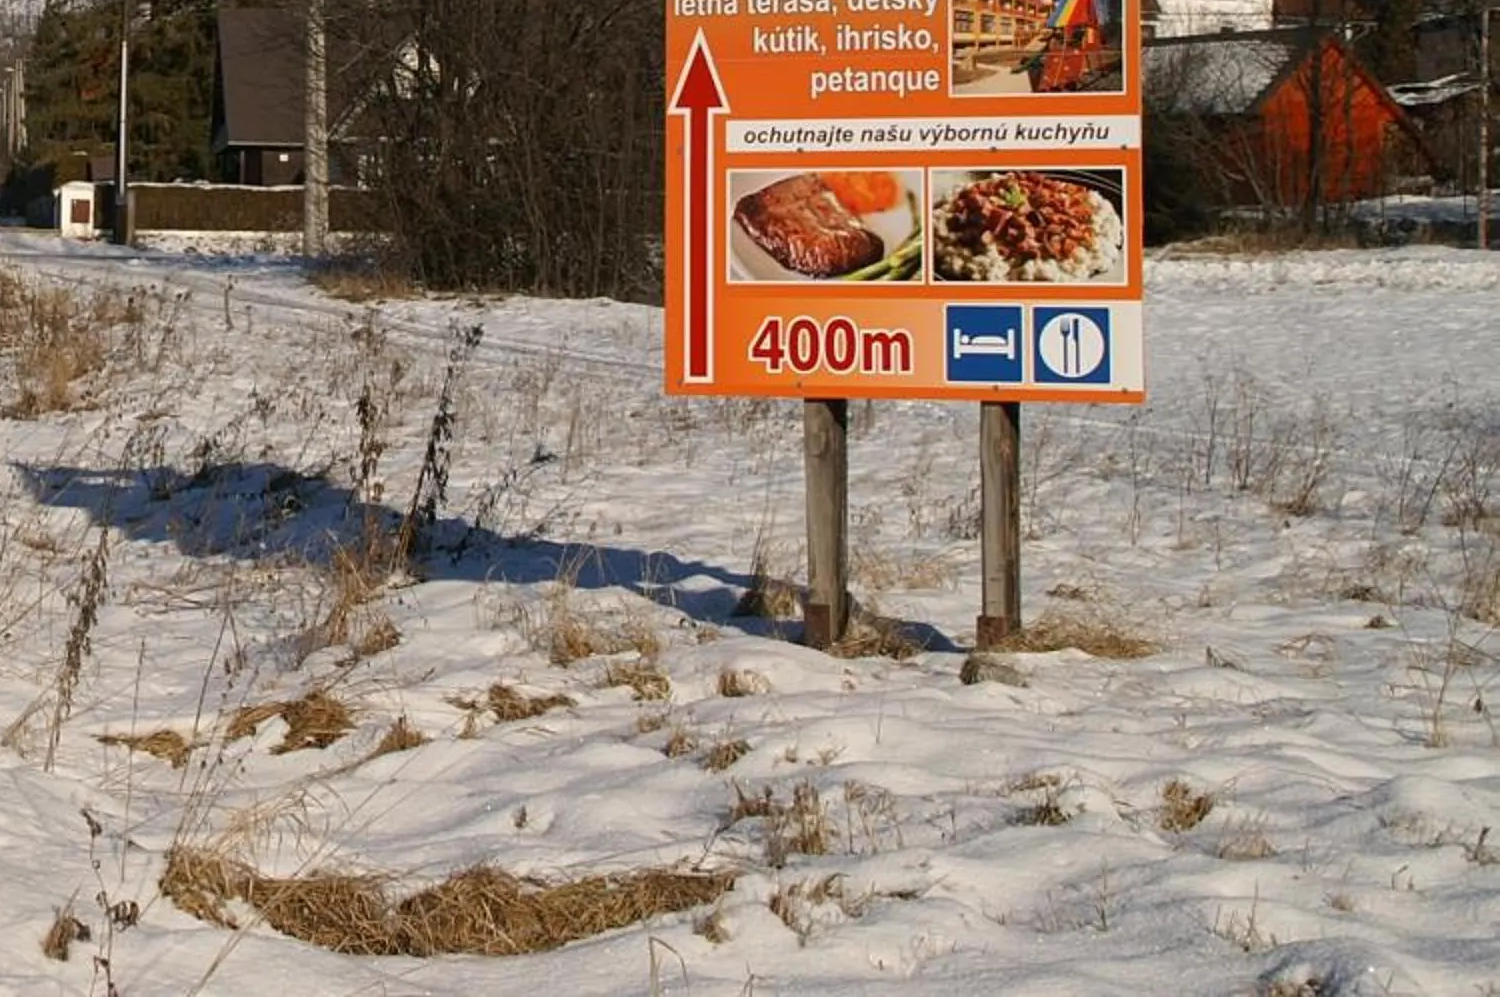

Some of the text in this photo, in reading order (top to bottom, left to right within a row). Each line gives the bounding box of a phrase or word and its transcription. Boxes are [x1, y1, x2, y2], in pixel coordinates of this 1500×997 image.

[753, 22, 940, 55] kútik, ihrisko,
[810, 67, 941, 99] petanque
[743, 121, 1110, 147] ochutnajte našu výbornú kuchyňu
[749, 315, 913, 374] 400m
